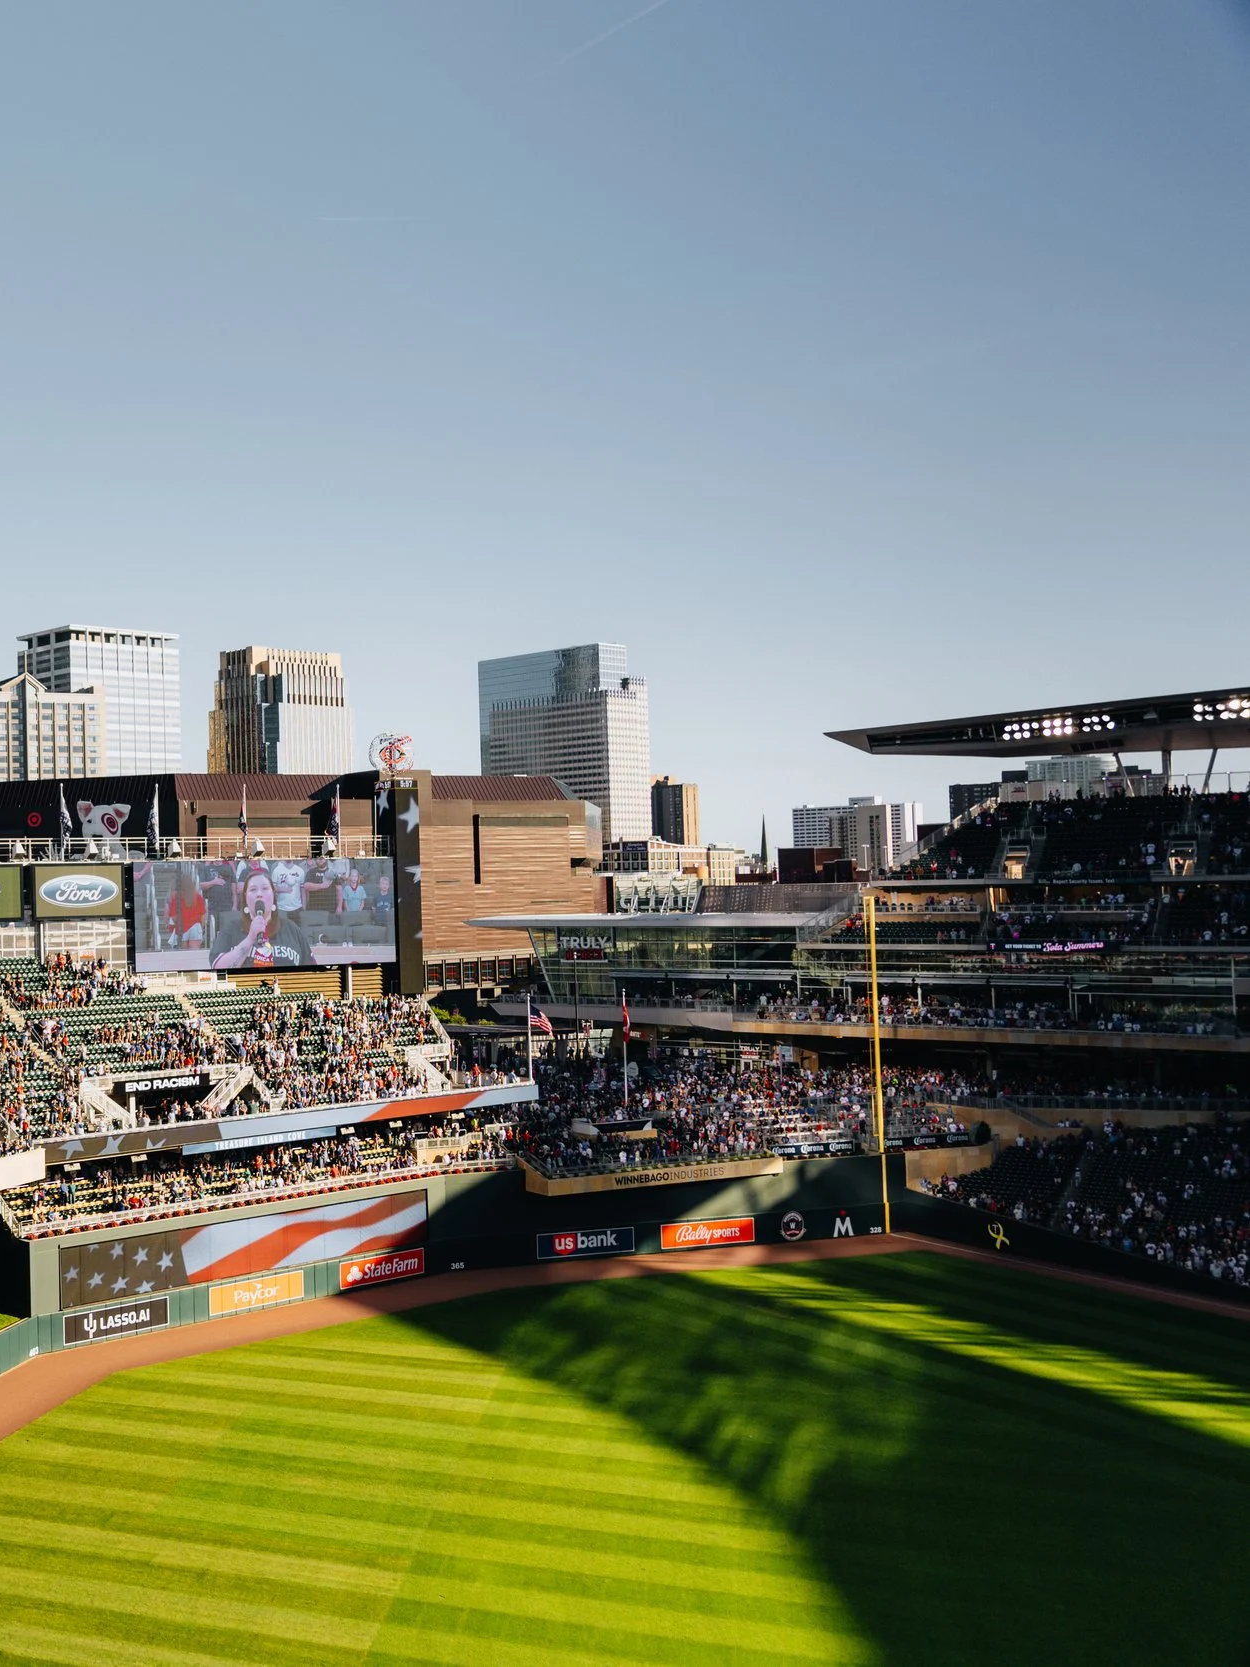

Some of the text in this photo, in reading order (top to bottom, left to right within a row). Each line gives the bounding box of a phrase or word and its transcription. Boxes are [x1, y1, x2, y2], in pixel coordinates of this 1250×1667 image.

[55, 880, 103, 902] Ford
[560, 937, 607, 949] TRULY
[125, 1076, 200, 1092] END RACISM
[214, 1131, 307, 1150] TREASURE ISLAND COVE
[772, 1142, 853, 1155] Corona Corona Corona
[913, 1136, 936, 1146] Corona
[946, 1133, 969, 1144] Corona
[676, 1224, 740, 1244] Bally SPORTS
[833, 1216, 854, 1237] M
[869, 1226, 882, 1234] 328
[577, 1231, 617, 1249] bank
[450, 1262, 465, 1270] 365
[234, 1284, 281, 1304] Paycor
[100, 1308, 150, 1330] LASSO.AI
